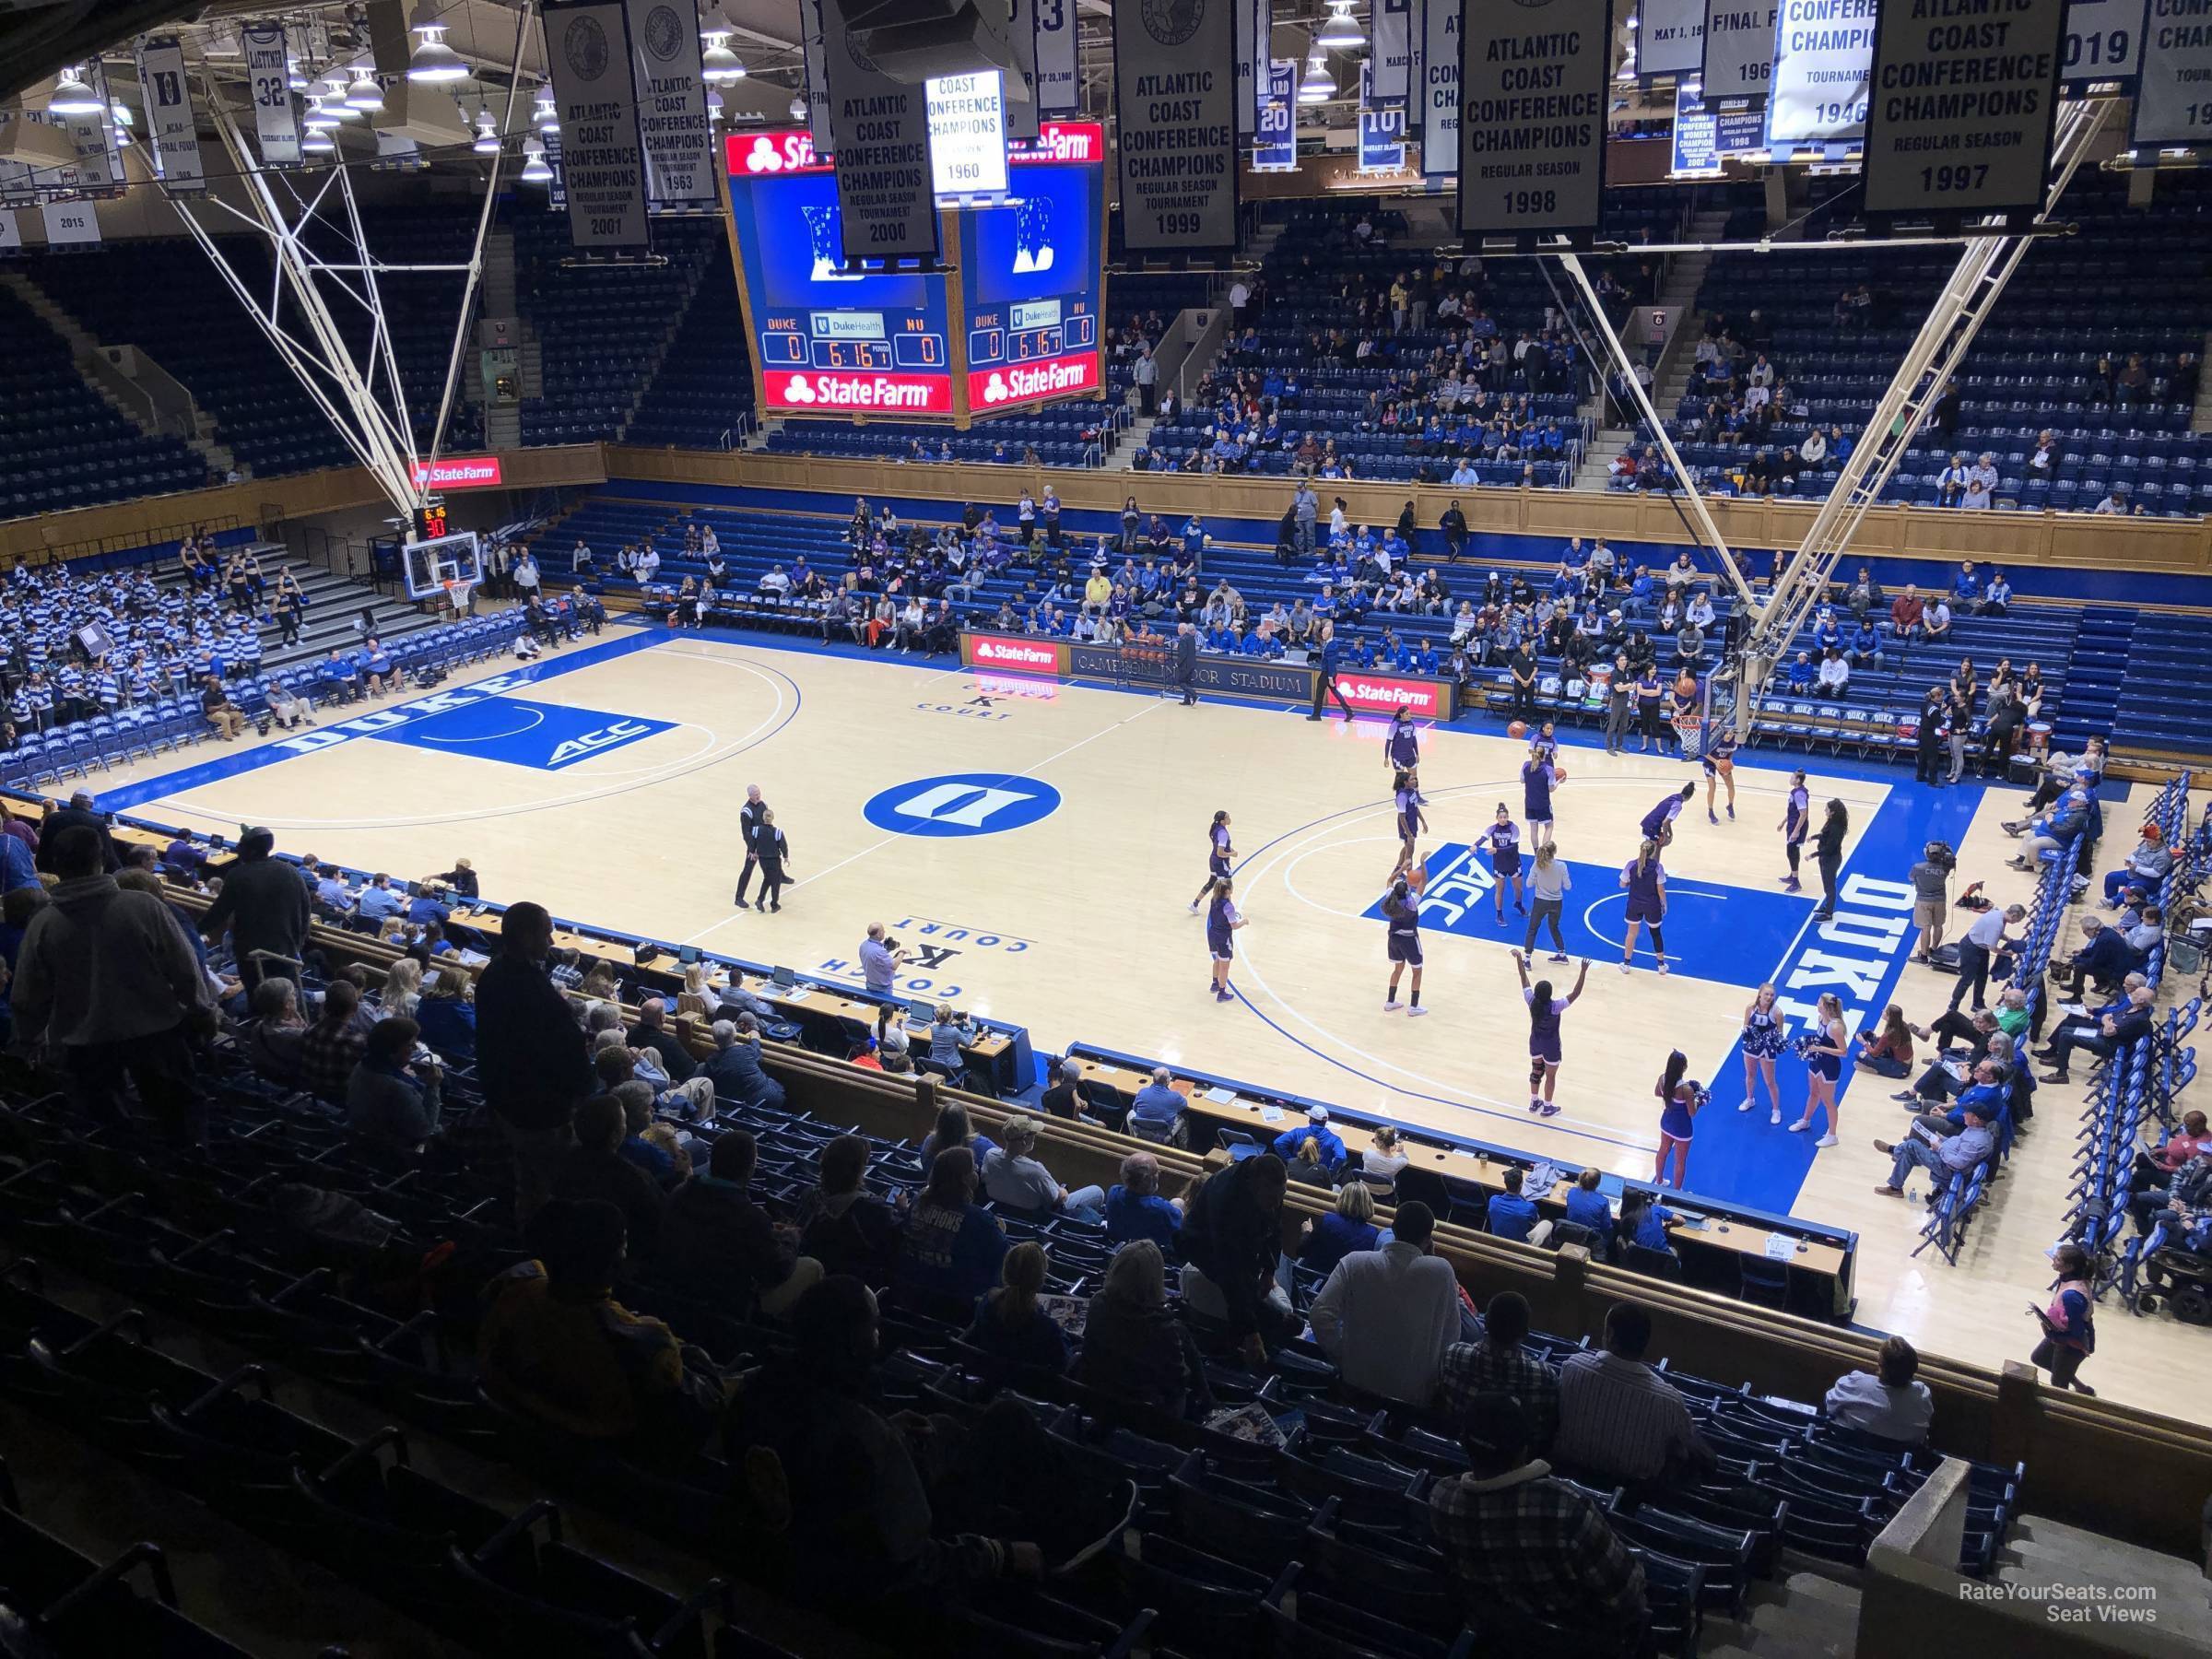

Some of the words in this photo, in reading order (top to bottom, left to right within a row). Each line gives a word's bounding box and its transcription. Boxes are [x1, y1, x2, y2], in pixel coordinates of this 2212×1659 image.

[1712, 11, 1761, 32] FINAL
[1789, 0, 1877, 22] CONFERE
[1654, 29, 1676, 41] MAY
[1791, 29, 1874, 52] CHAMPI
[1927, 22, 2010, 53] COAST
[1487, 31, 1581, 63] ATLANTIC
[2063, 29, 2130, 68] 019
[1386, 52, 1407, 67] MARC
[1501, 65, 1565, 92] COAST
[1739, 63, 1771, 82] 196
[1807, 69, 1869, 84] TOURNAME
[1882, 53, 2051, 89] CONFERENCE
[257, 77, 285, 106] 32
[939, 76, 976, 94] COAST
[1136, 71, 1213, 97] ATLANTIC
[569, 102, 621, 122] ATLANTIC
[655, 97, 687, 112] COAST
[843, 94, 907, 118] ATLANTIC
[929, 96, 998, 116] ONFERENCE
[1149, 100, 1202, 123] COAST
[1467, 92, 1598, 124] CONFERENCE
[1815, 101, 1867, 124] 1946
[1886, 88, 2039, 123] CHAMPIONS
[641, 114, 705, 133] CONFERENCE
[856, 121, 900, 141] COAST
[1261, 109, 1288, 132] 20
[1369, 112, 1395, 133] 10
[1720, 115, 1762, 127] CHAMPIONS
[578, 125, 615, 144] COAST
[646, 134, 704, 150] CHAMPIONS
[1124, 125, 1230, 152] CONFERENCE
[1472, 124, 1592, 153] CHAMPIONS
[1894, 134, 1962, 152] REGULAR
[1964, 131, 2022, 149] SEASON
[564, 147, 637, 167] CONFERENCE
[837, 142, 924, 167] CONFERENCE
[948, 163, 980, 179] 1960
[1128, 153, 1224, 178] CHAMPIONS
[1481, 163, 1533, 179] REGULAR
[1535, 161, 1581, 176] SEASON
[569, 170, 636, 189] CHAMPIONS
[665, 175, 693, 190] 1963
[841, 167, 922, 192] CHAMPIONS
[1136, 181, 1179, 194] REGULAR
[1181, 179, 1218, 193] SEASON
[1921, 164, 1990, 193] 1997
[850, 192, 888, 206] REGULAR
[888, 190, 916, 204] SEASON
[1145, 194, 1210, 210] TOURNAMENT
[1503, 190, 1557, 214] 1998
[61, 218, 85, 229] 2015
[859, 206, 911, 220] TOURNAMENT
[1156, 213, 1201, 234] 1999
[591, 218, 621, 235] 2001
[870, 221, 906, 243] 2000
[768, 318, 797, 330] DUKE
[906, 319, 924, 331] NU
[975, 314, 998, 328] DUKE
[1081, 319, 1089, 342] 0
[788, 335, 802, 360] 0
[830, 342, 873, 368] 6:16
[872, 345, 889, 353] PERIOD
[922, 336, 935, 362] 0
[990, 332, 998, 358] 0
[1019, 330, 1049, 359] 6:16
[425, 506, 446, 520] 6:16
[426, 519, 446, 538] 30
[962, 685, 1059, 700] COACH
[1230, 672, 1302, 694] STADIUM
[917, 702, 1012, 721] COURT
[965, 695, 1007, 708] K
[1767, 701, 1785, 712] DUKE
[1794, 703, 1813, 714] DUKE
[1820, 706, 1840, 717] DUKE
[274, 676, 533, 753] DUKE
[1847, 710, 1866, 721] DUKE
[1874, 712, 1894, 724] DUKE
[1901, 714, 1921, 726] DUKE
[548, 720, 645, 762] ACC
[1418, 856, 1497, 928] ACC
[892, 918, 1030, 953] COURT
[900, 943, 964, 971] K
[1776, 873, 1917, 1049] DUKE
[818, 958, 964, 998] COCH
[1754, 1014, 1769, 1027] D
